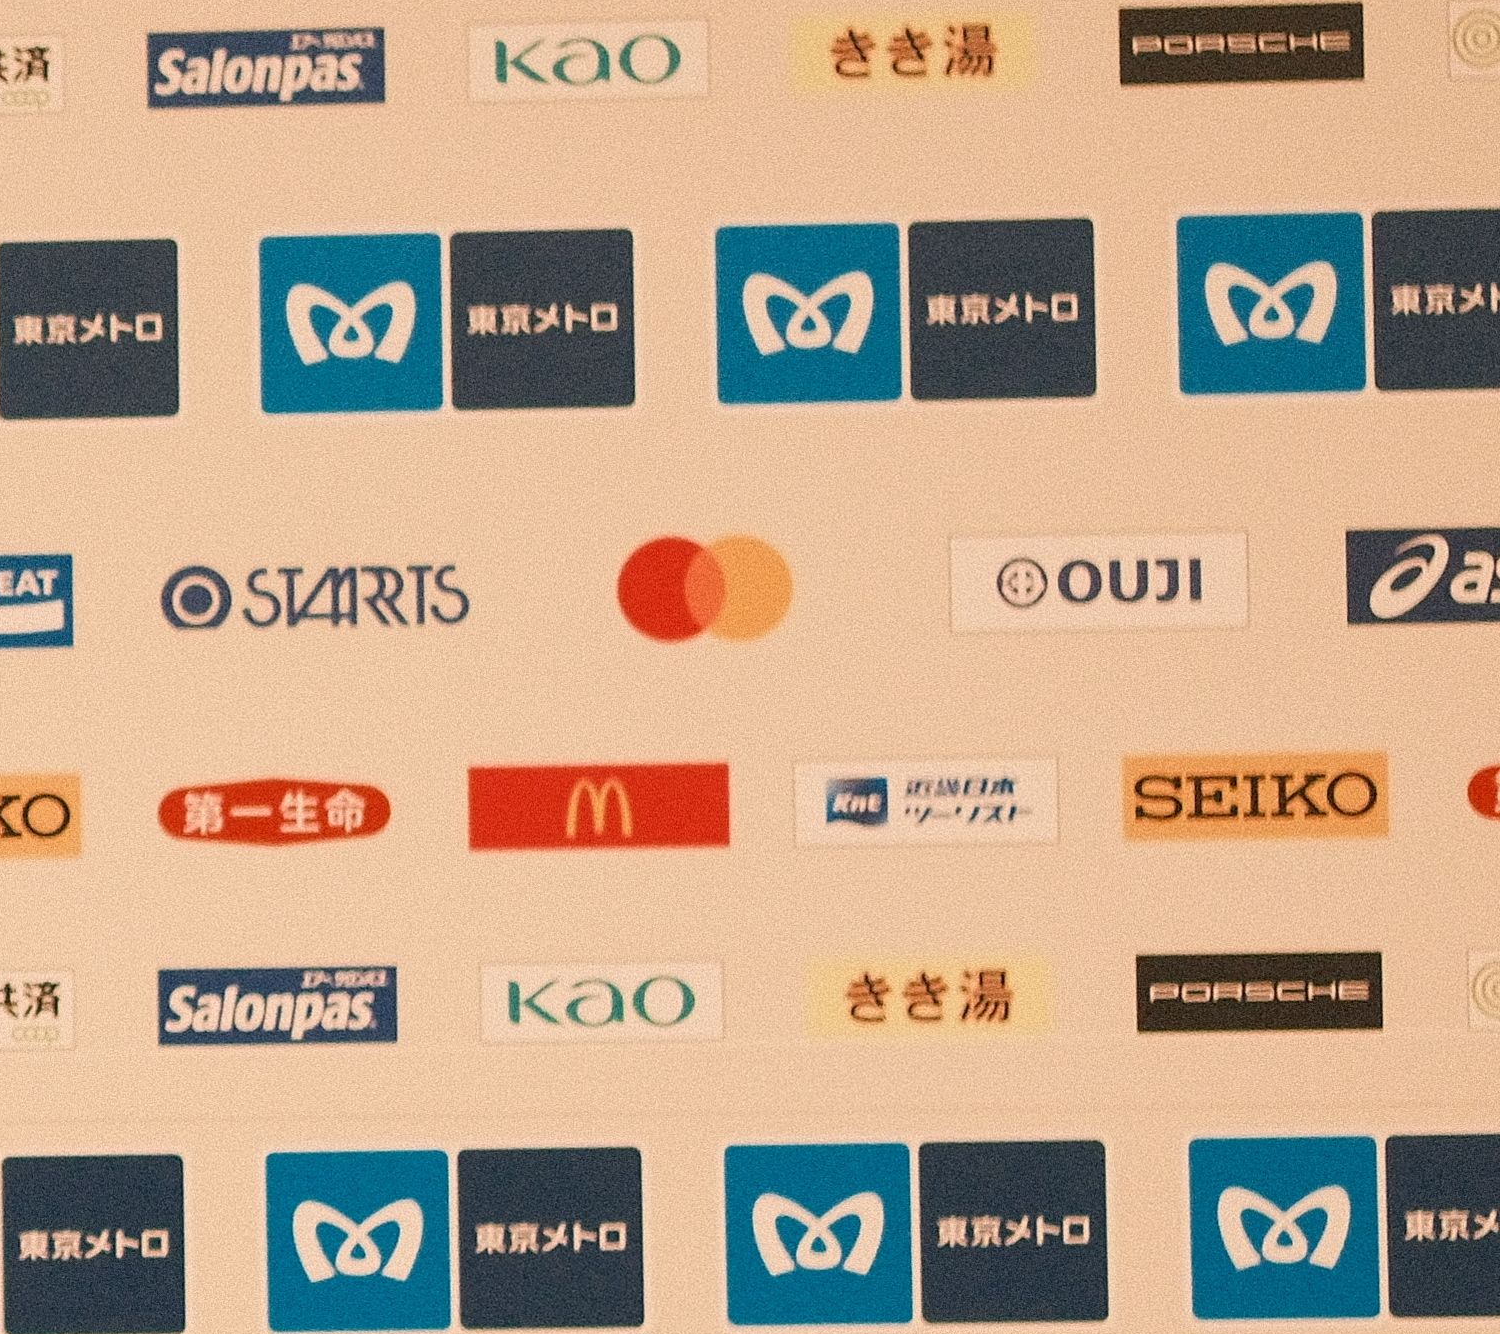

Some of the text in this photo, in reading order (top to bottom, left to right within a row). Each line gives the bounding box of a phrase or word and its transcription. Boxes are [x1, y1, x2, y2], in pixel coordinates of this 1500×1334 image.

[155, 49, 361, 102] Salonpas
[15, 314, 162, 344] 東京メトロ
[928, 294, 1078, 324] 東京メトロ
[1058, 558, 1201, 604] OUJI
[185, 789, 365, 834] 第一生命
[1134, 771, 1377, 821] SEIKO
[166, 986, 373, 1040] Salonpas
[848, 970, 1011, 1022] きき湯
[20, 1230, 169, 1260] 東京メトロ
[939, 1216, 1090, 1246] 東京メトロ
